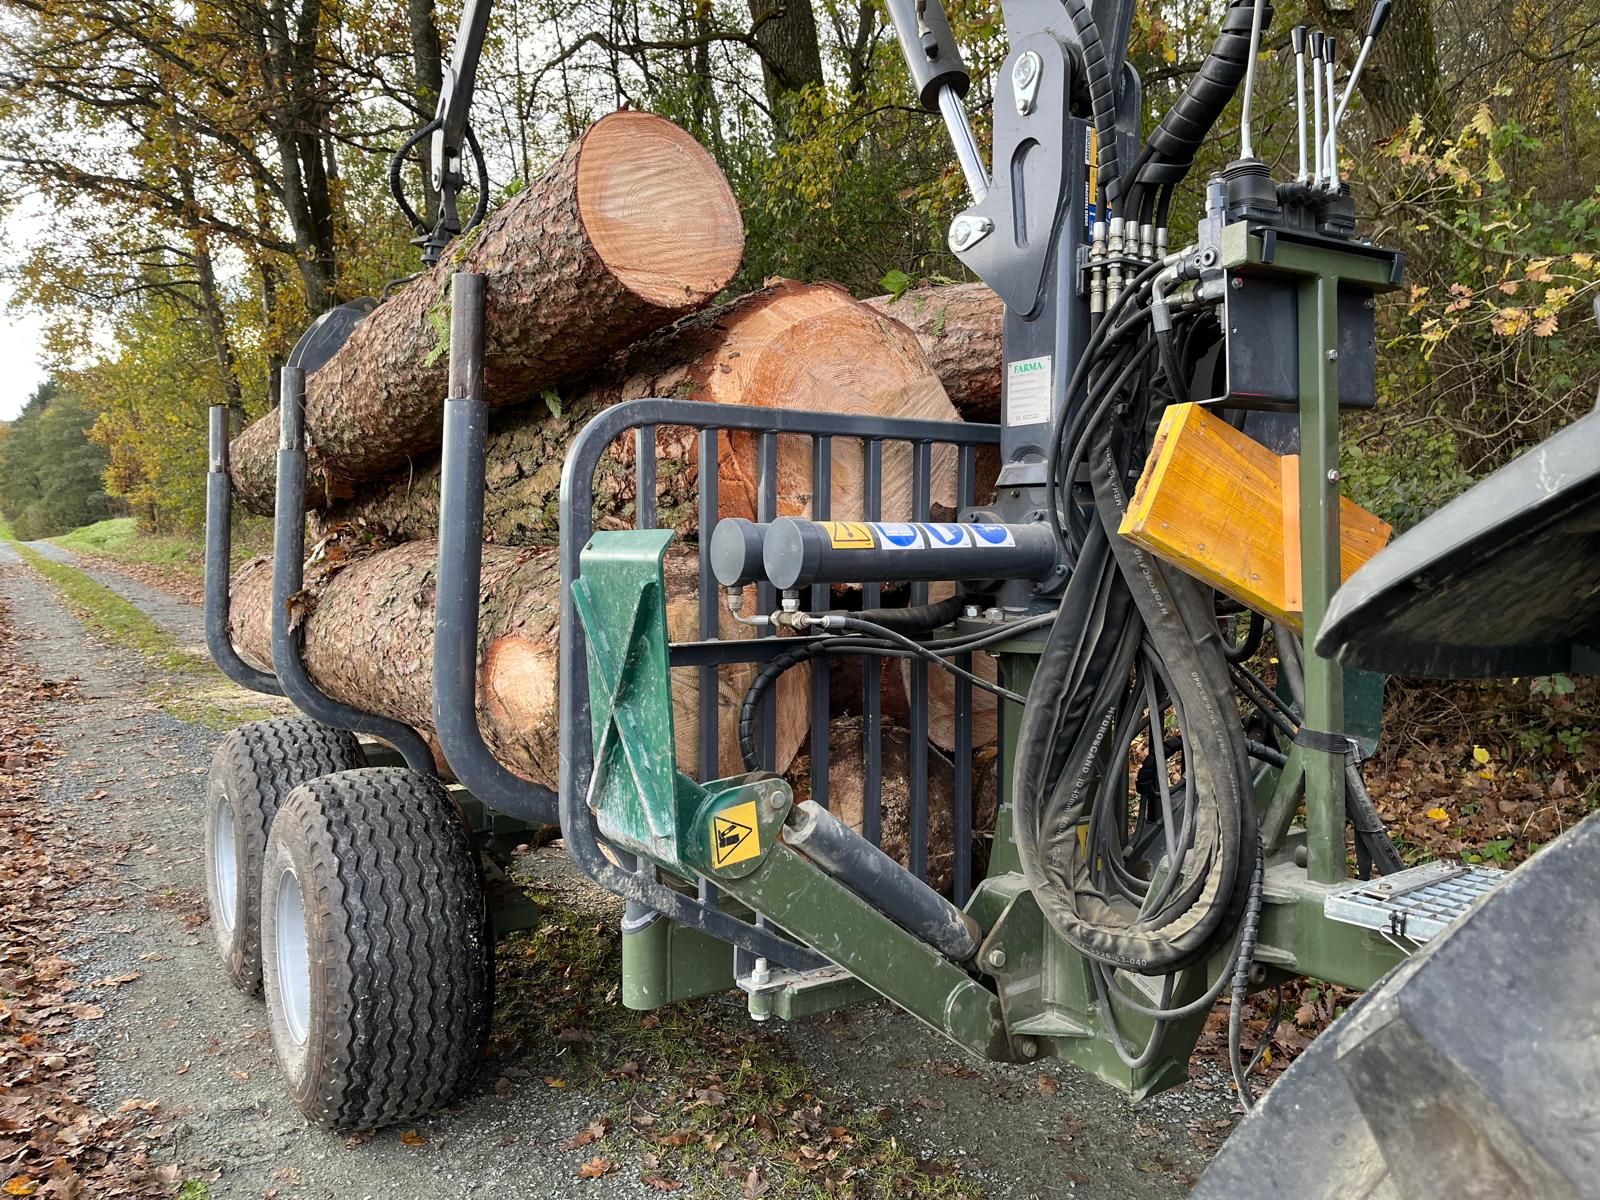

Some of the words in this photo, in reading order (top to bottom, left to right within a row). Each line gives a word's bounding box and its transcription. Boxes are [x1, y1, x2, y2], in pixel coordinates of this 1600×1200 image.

[1014, 361, 1042, 374] FARMA
[1134, 549, 1168, 616] HYDROSCAND
[1082, 706, 1116, 774] HYDROSCAND
